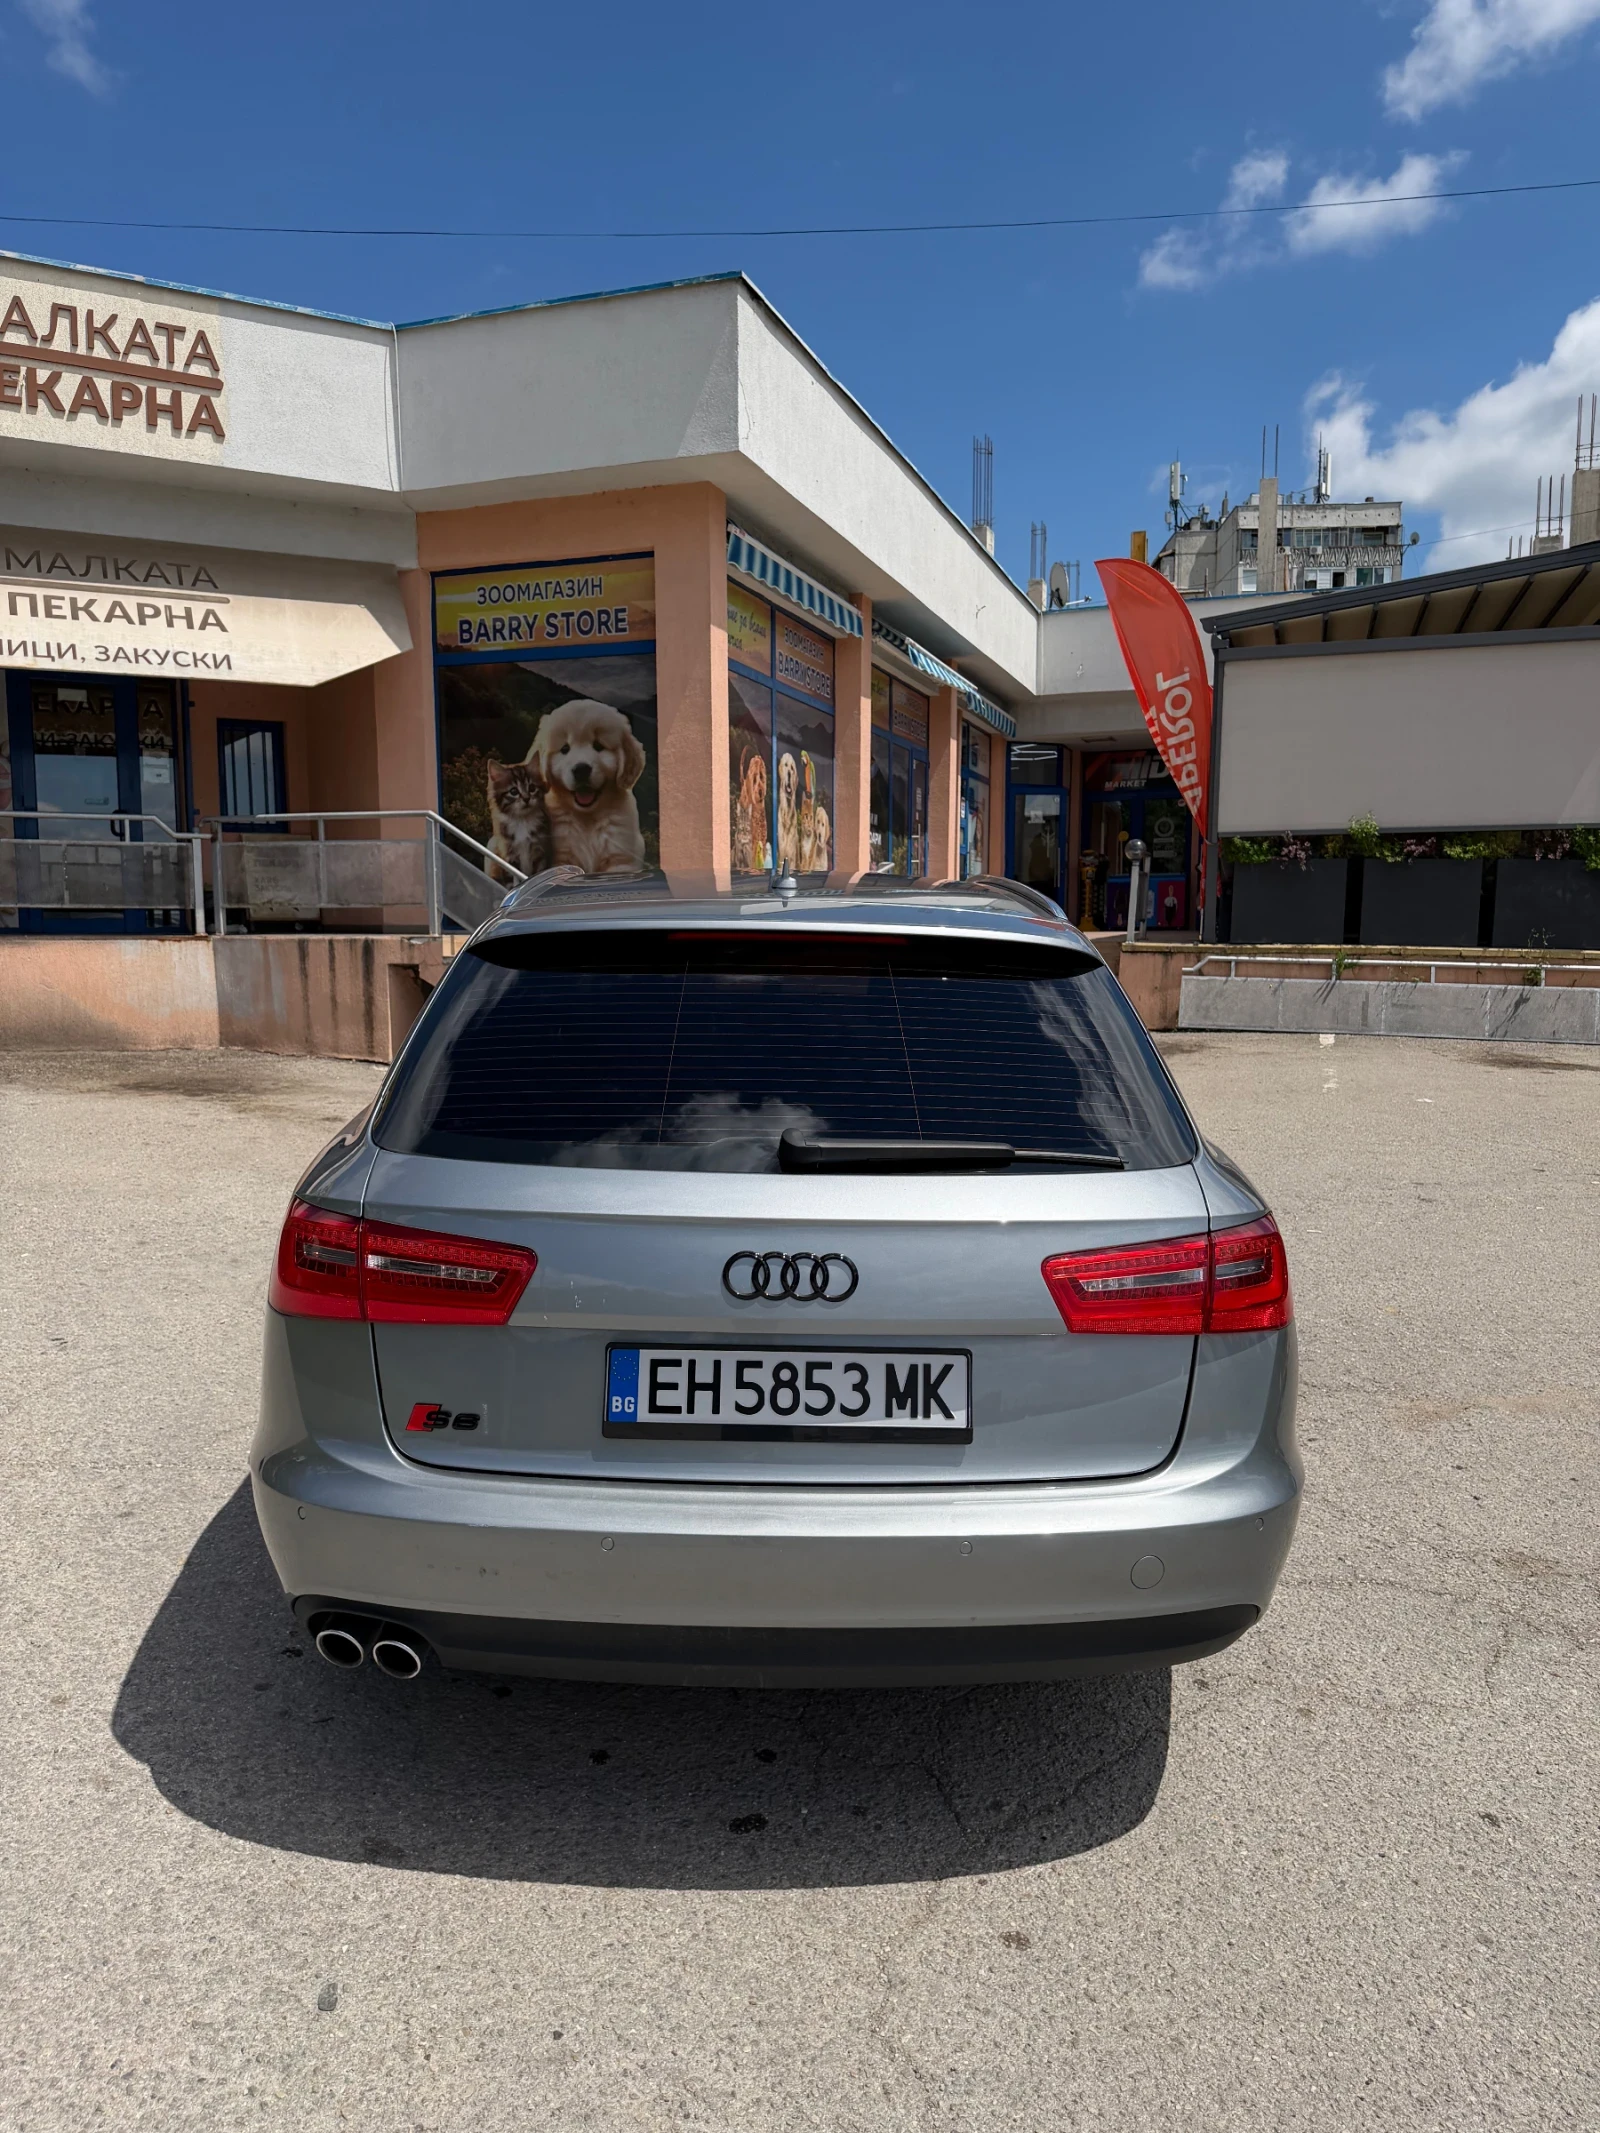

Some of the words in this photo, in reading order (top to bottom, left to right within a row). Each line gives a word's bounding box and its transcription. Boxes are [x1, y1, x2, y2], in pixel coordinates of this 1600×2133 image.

[4, 547, 219, 589] МАЛКАТА
[477, 576, 603, 606] ЗООМАГАЗИН
[7, 591, 229, 633] ПЕКАРНА
[458, 613, 540, 645] BARRY
[544, 606, 629, 640] STORE
[0, 638, 86, 663] ИЦИ,
[94, 644, 233, 671] ЗАКУСКИ
[778, 649, 806, 685] BARRY
[805, 664, 831, 698] STORE
[1104, 779, 1147, 790] MARKET
[611, 1396, 635, 1413] BG
[648, 1358, 722, 1415] EH
[734, 1360, 871, 1417] 5853
[885, 1363, 955, 1420] MK
